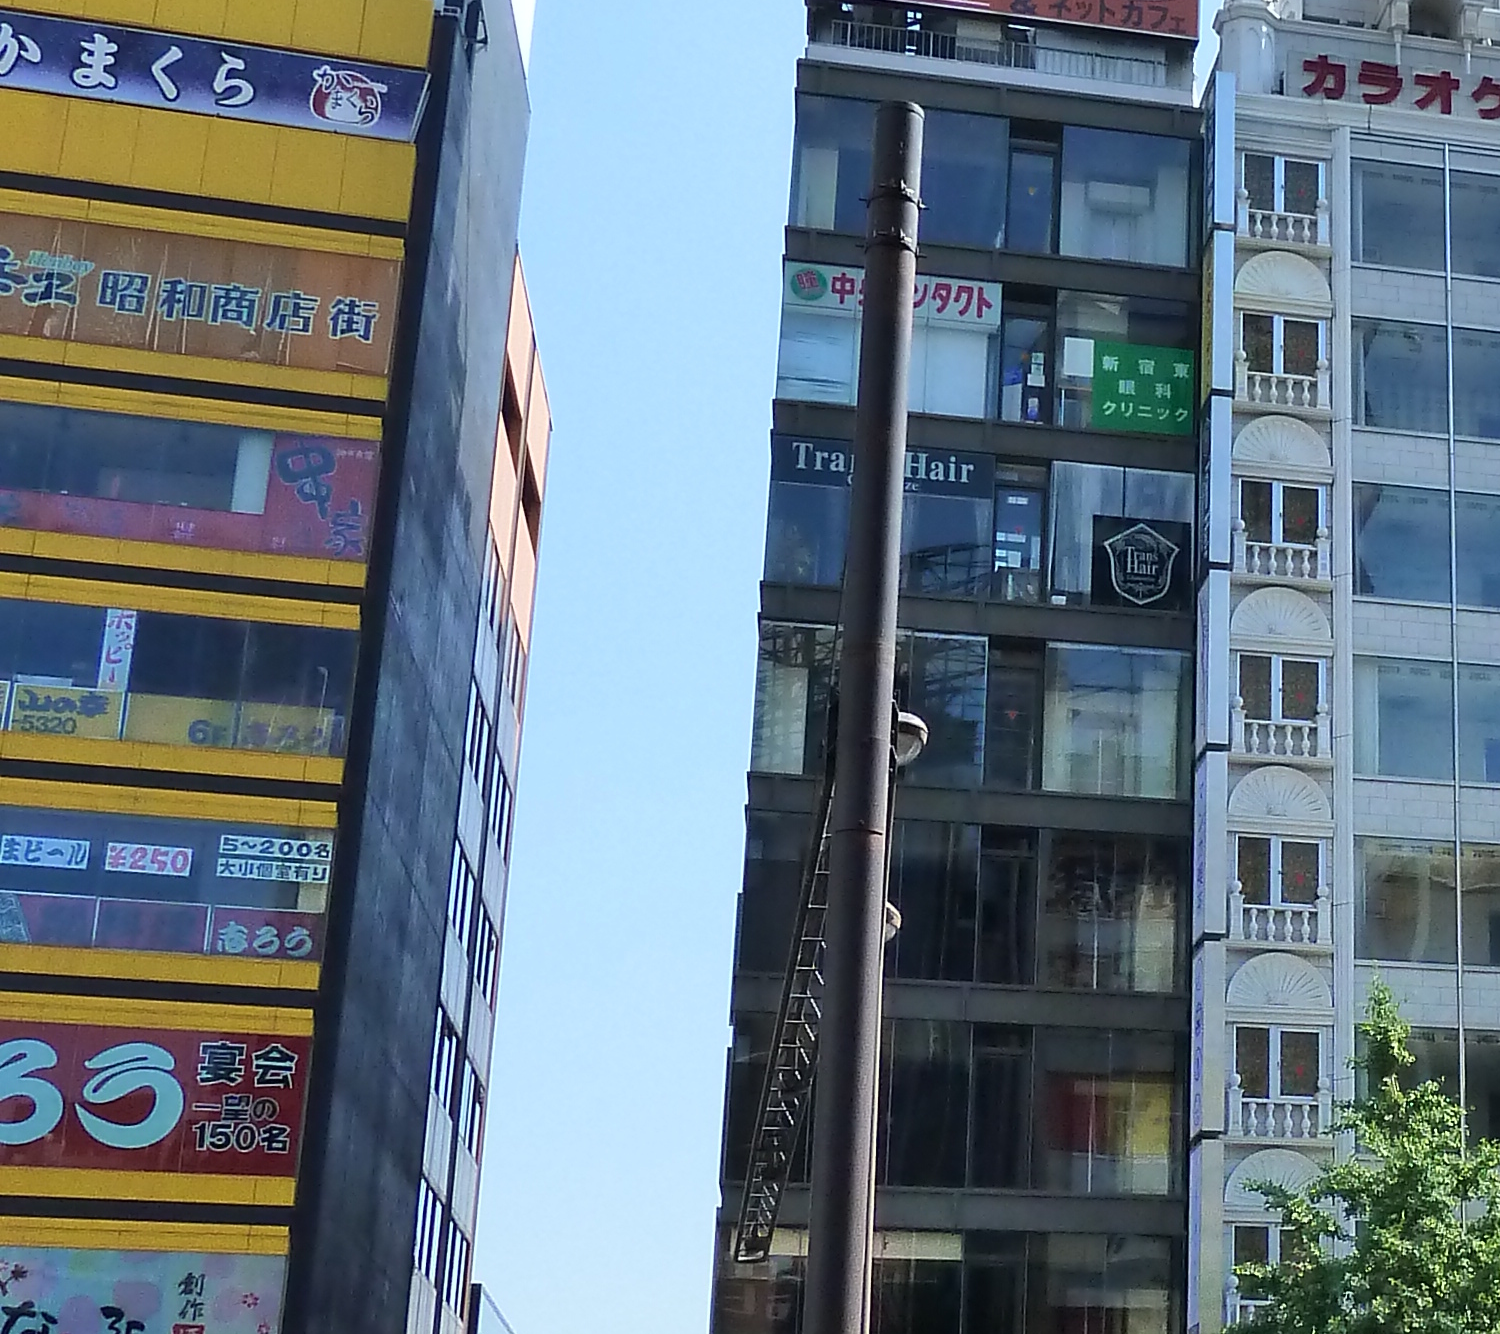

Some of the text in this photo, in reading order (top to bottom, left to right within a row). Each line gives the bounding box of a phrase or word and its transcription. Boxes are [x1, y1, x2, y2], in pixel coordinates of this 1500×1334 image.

[96, 269, 381, 344] 昭和商店街
[831, 271, 994, 319] 中ンタクト
[1102, 354, 1190, 380] 新宿東
[1118, 379, 1172, 400] 眼科
[1102, 401, 1188, 423] クリニック
[792, 441, 856, 473] Tra
[904, 451, 974, 485] Hair
[1125, 546, 1159, 563] Trans
[1126, 559, 1159, 575] Hair
[104, 611, 136, 684] ホッピー
[2, 836, 190, 874] 生ビール ¥250
[218, 859, 329, 884] 大小個室有り
[197, 1040, 297, 1089] 宴会
[192, 1093, 279, 1123] 一望の
[193, 1121, 290, 1154] 150名
